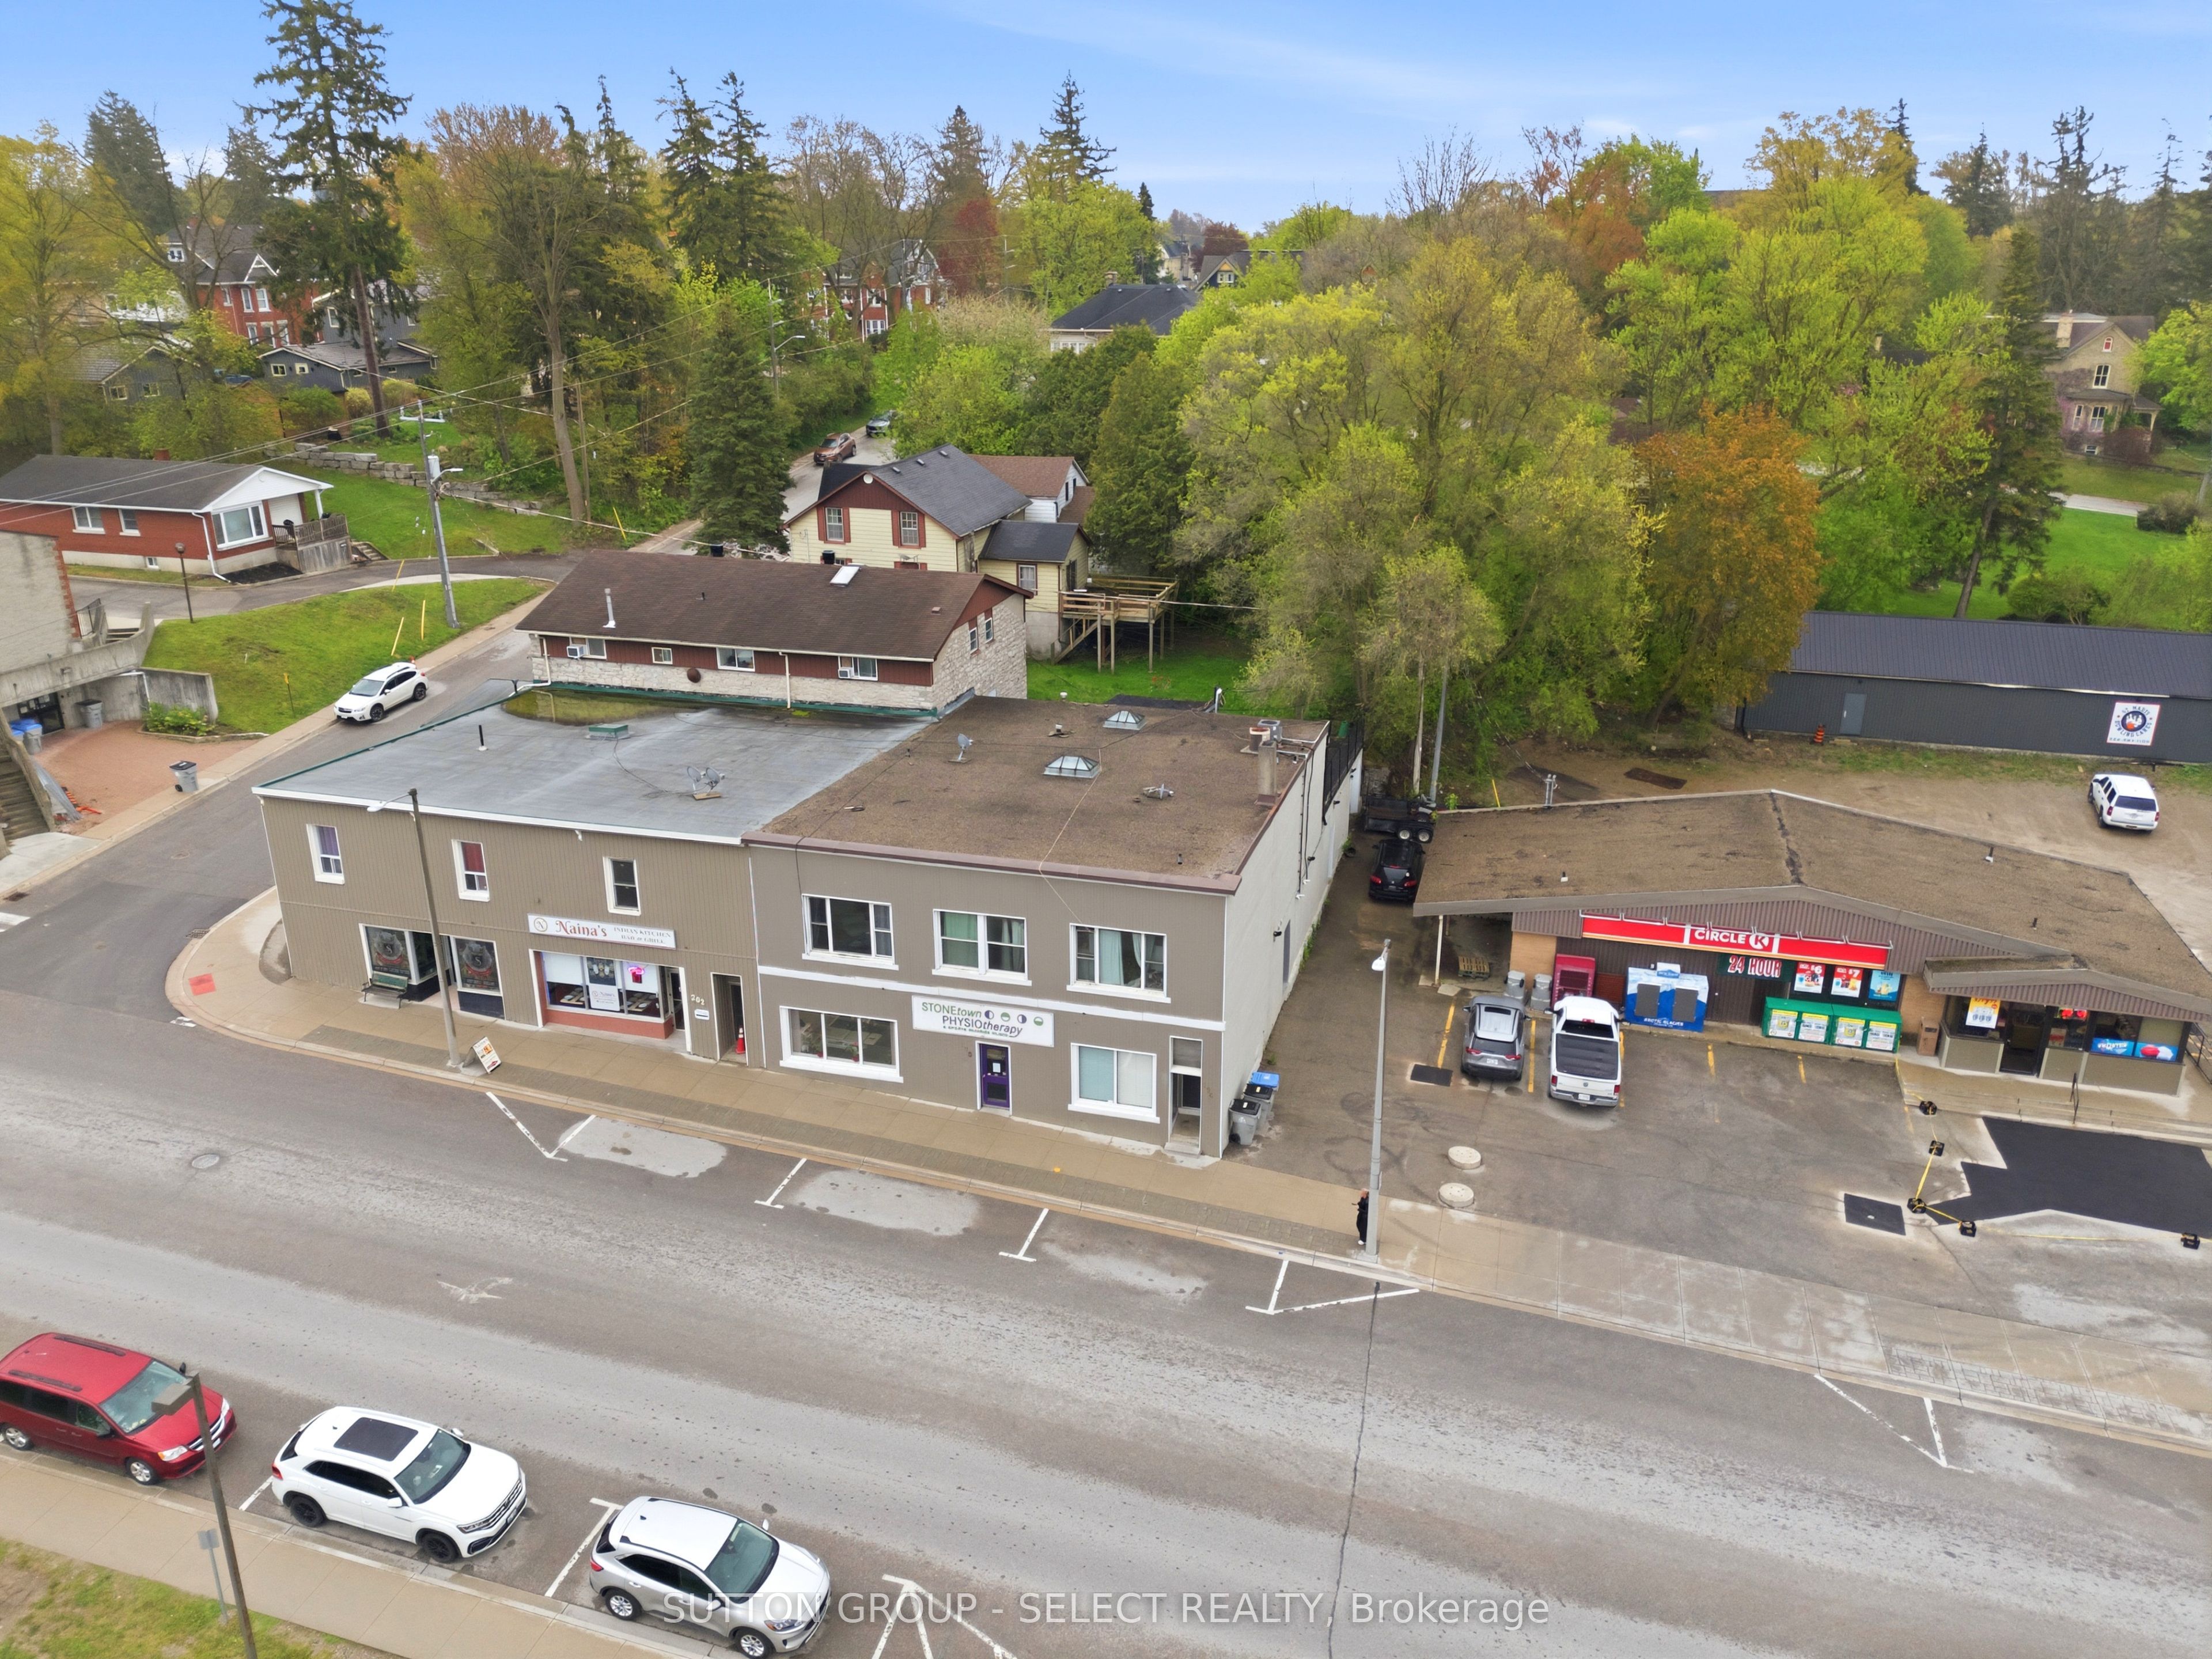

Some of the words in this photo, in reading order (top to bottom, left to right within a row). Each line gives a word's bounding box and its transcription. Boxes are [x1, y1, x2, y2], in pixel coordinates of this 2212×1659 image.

[555, 920, 607, 937] Naina's
[1694, 929, 1746, 944] CIRCLE
[1753, 934, 1768, 948] K
[1728, 955, 1745, 974] 24
[1748, 957, 1782, 978] HOUR
[691, 994, 705, 1005] 202
[922, 1002, 982, 1018] STONEtown
[942, 1015, 1023, 1037] PHYSIOtherapy
